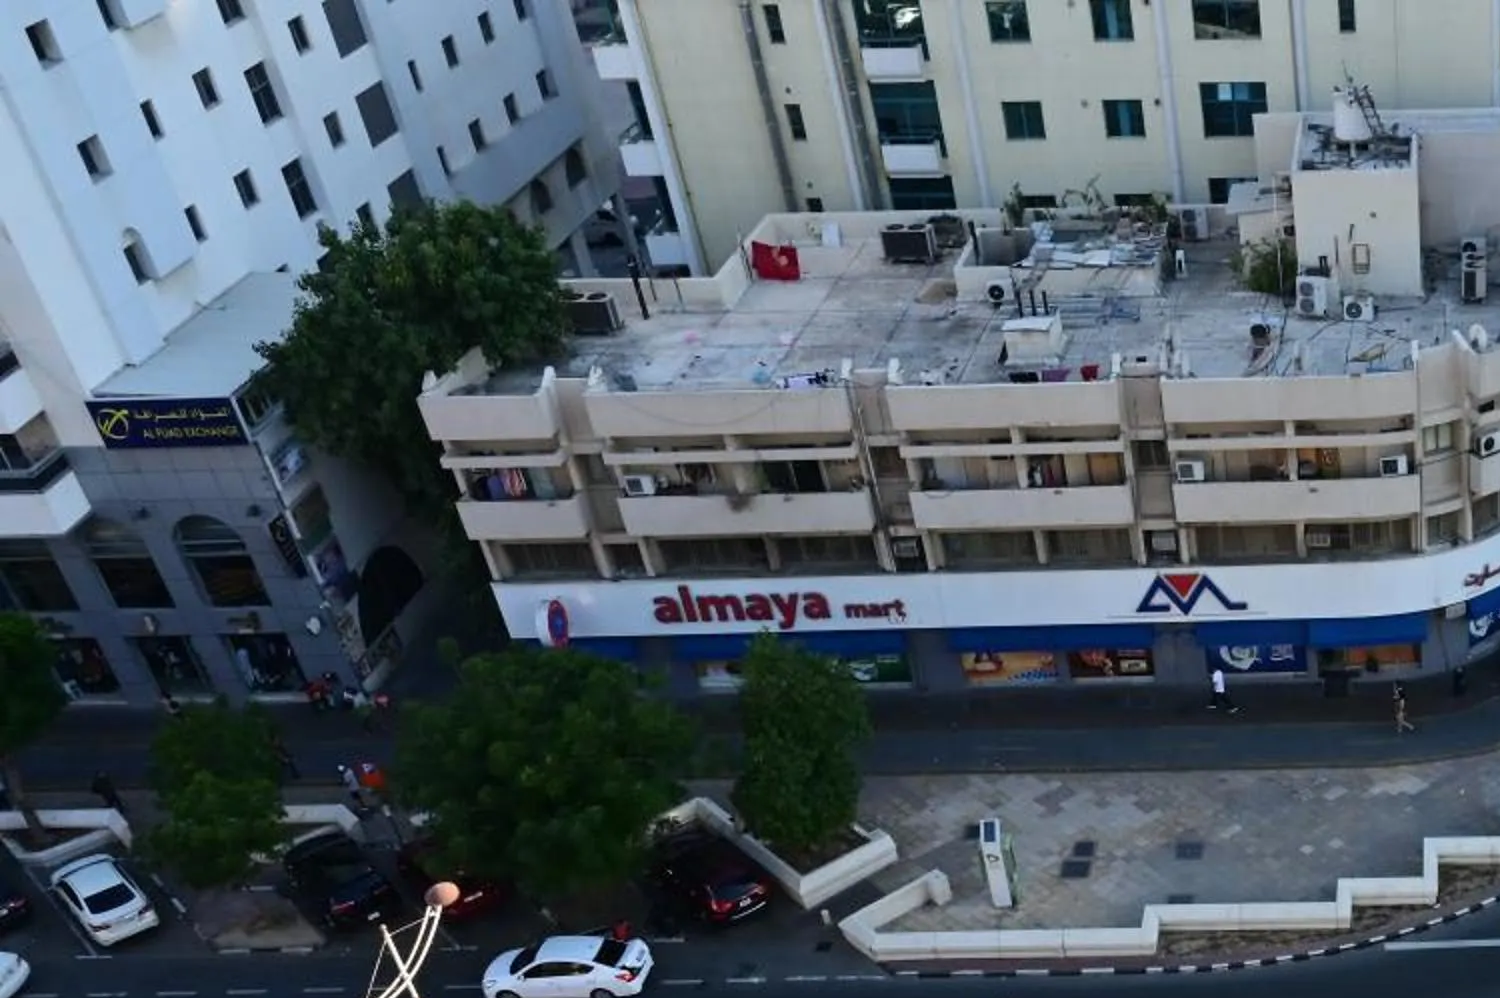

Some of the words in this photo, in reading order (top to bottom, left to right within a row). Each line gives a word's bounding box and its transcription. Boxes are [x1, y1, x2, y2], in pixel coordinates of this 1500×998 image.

[143, 428, 155, 439] AL
[185, 425, 238, 438] EXCHANGE
[653, 584, 833, 630] almaya
[843, 599, 908, 620] mart
